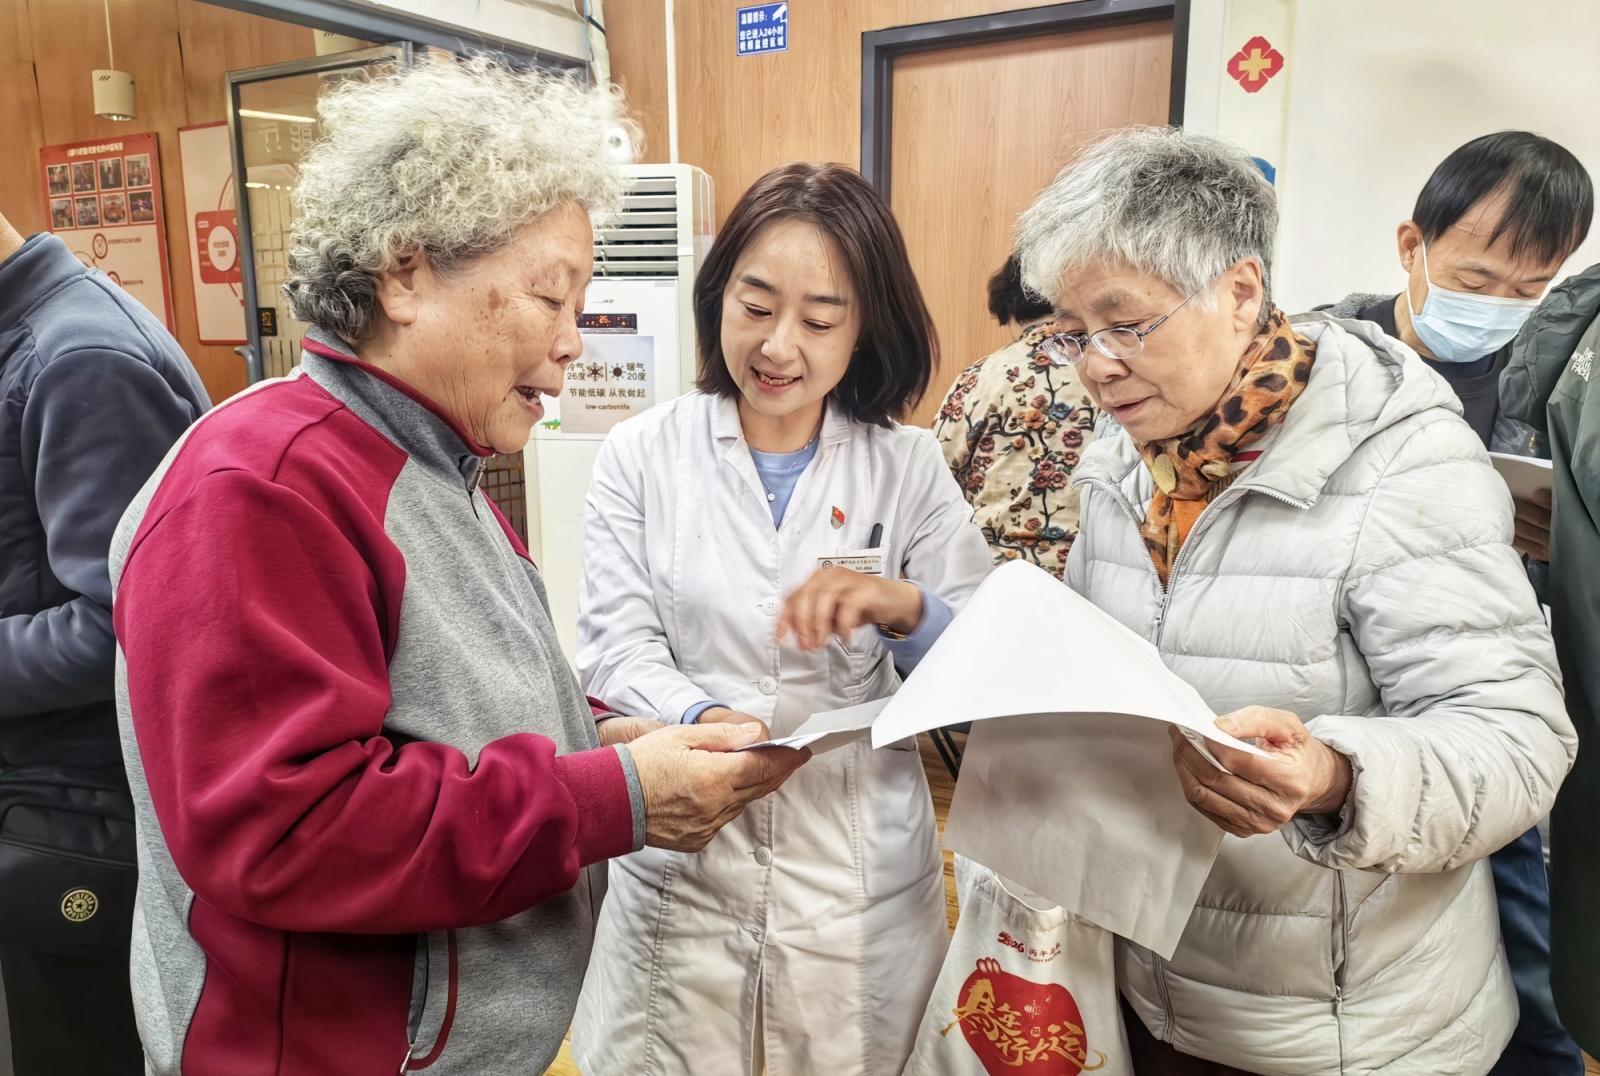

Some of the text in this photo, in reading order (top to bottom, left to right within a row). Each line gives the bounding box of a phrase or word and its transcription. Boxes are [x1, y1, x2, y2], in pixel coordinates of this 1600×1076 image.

[567, 362, 585, 372] 冷气
[626, 362, 646, 372] 暖气
[567, 372, 587, 381] 26度
[626, 372, 647, 381] 20度
[569, 387, 646, 398] 节能低碳 从我做起
